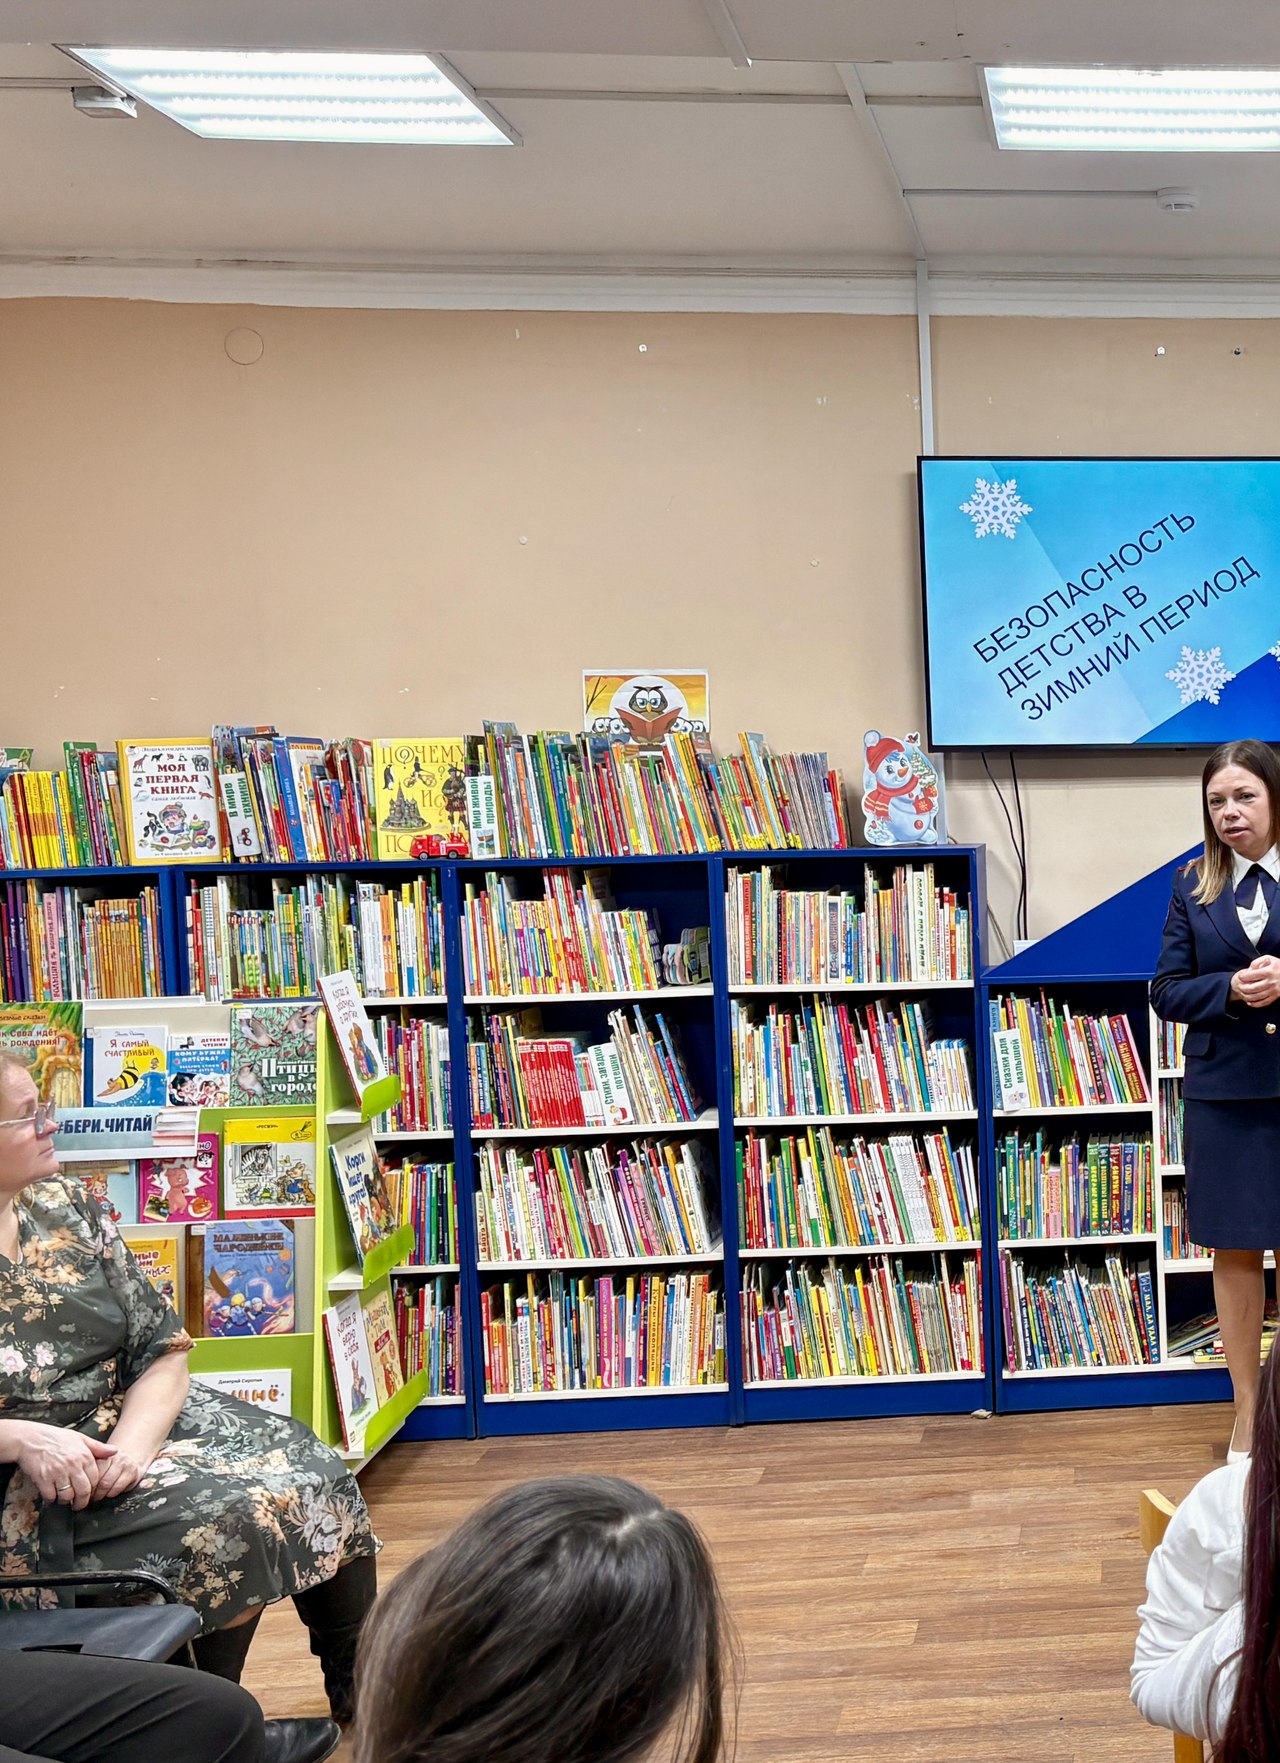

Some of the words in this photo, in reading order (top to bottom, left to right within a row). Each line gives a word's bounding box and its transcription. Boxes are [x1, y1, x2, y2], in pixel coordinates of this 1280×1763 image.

[972, 511, 1196, 664] БЕЗОПАСНОСТЬ
[997, 602, 1126, 698] ДЕТСТВА
[1127, 585, 1148, 609] В
[1020, 632, 1141, 721] ЗИМНИЙ
[1139, 556, 1262, 644] ПЕРИОД
[157, 763, 186, 773] МОЯ
[382, 744, 466, 766] ПОЧЕМУ
[146, 774, 200, 784] ПЕРВАЯ
[150, 785, 196, 795] КНИГА
[469, 778, 481, 808] живой
[224, 782, 237, 810] мире
[237, 778, 253, 819] техники
[483, 781, 495, 824] природы
[472, 807, 482, 829] Мир
[10, 1039, 60, 1048] рождения!
[110, 1039, 117, 1048] Я
[999, 1037, 1010, 1056] для
[609, 1054, 625, 1090] потешки
[1002, 1057, 1013, 1089] Сказки
[1011, 1038, 1025, 1083] малышей
[287, 1074, 295, 1082] в
